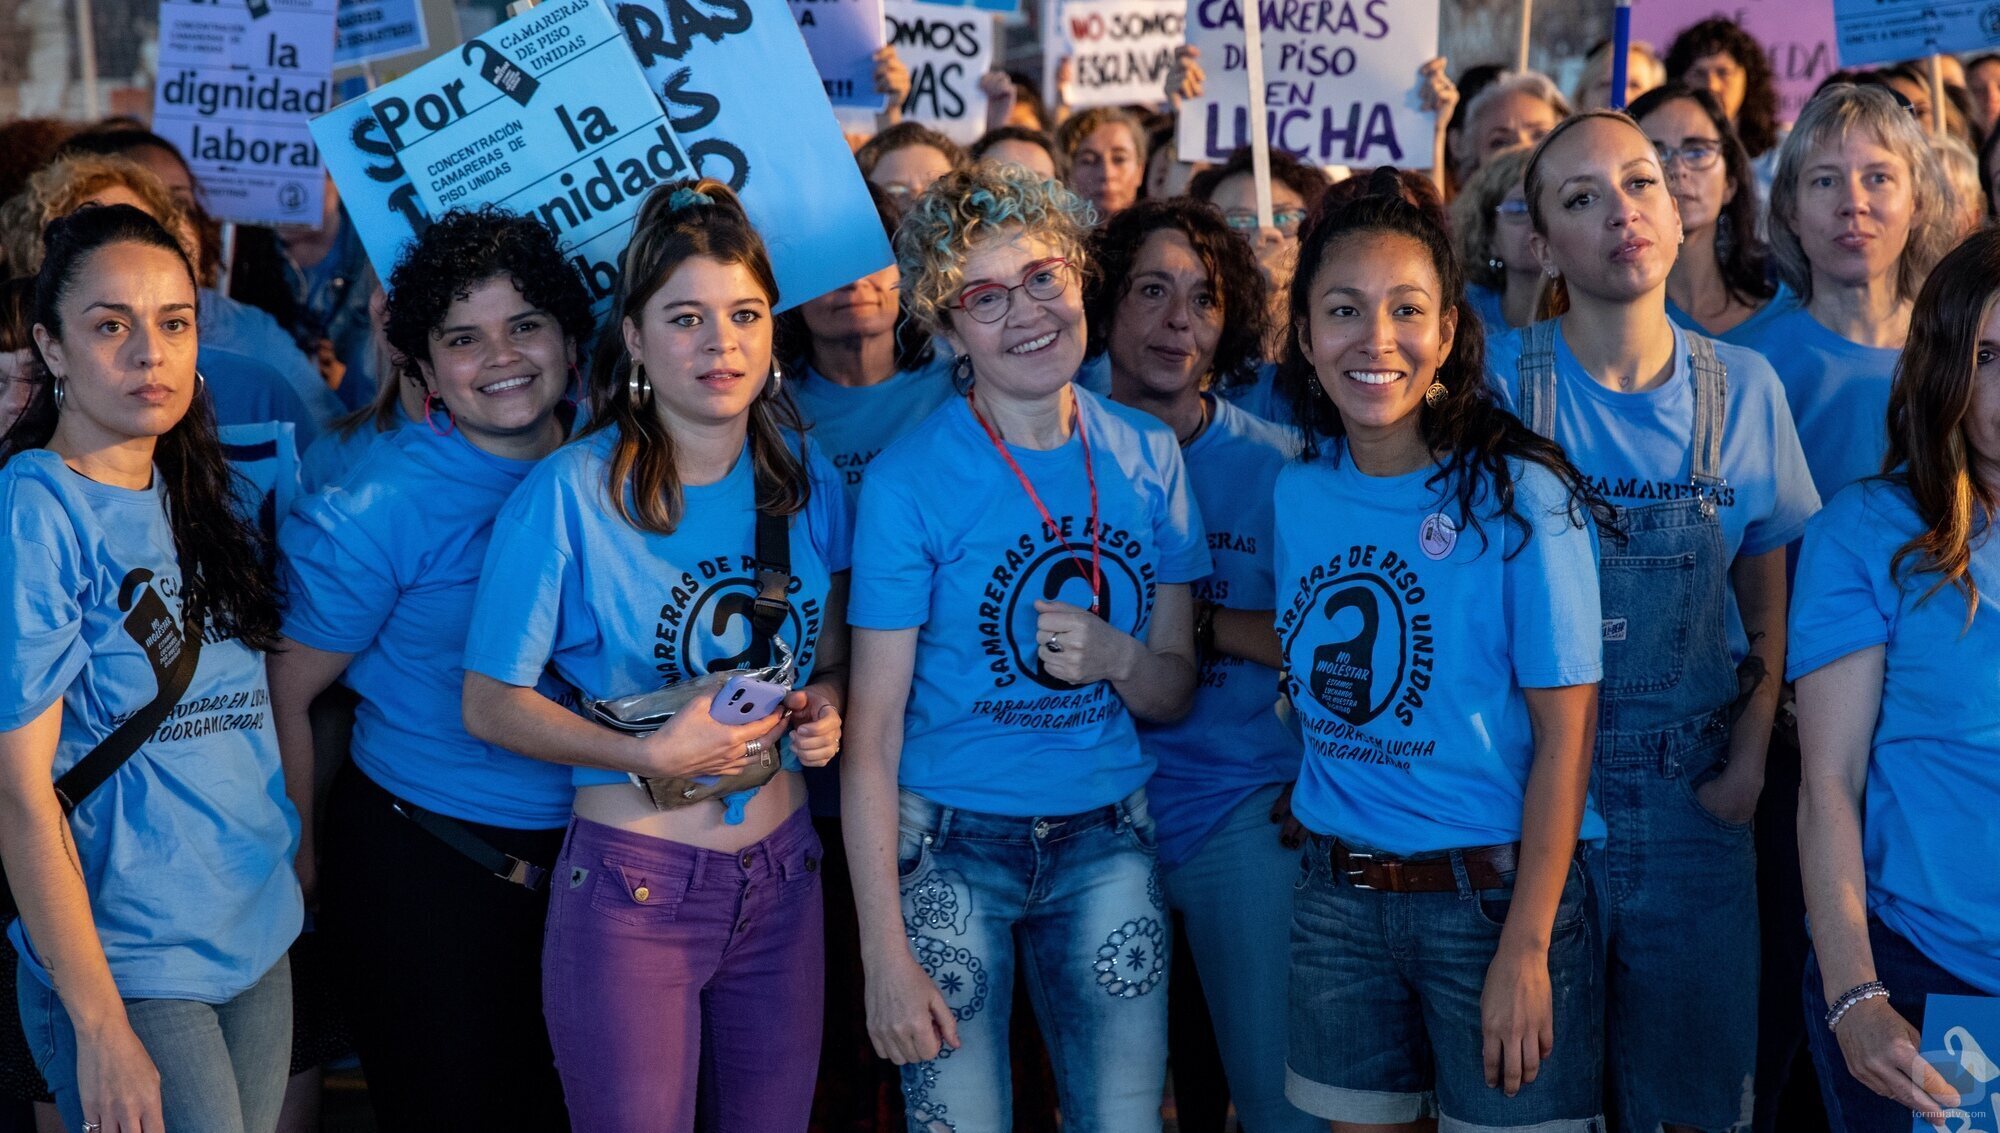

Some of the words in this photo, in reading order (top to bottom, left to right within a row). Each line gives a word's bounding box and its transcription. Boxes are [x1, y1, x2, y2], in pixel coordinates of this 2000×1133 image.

[500, 0, 589, 49] CAMARERAS
[515, 42, 537, 60] DE
[538, 25, 571, 50] PISO
[268, 33, 299, 68] la
[530, 34, 587, 70] UNIDAS
[164, 71, 327, 115] dignidad
[371, 78, 469, 151] Por
[1265, 81, 1315, 105] EN
[192, 125, 320, 168] laboral
[427, 119, 524, 178] CONCENTRACIÓN
[554, 104, 619, 154] la
[1206, 102, 1404, 160] LUCHA
[431, 148, 504, 193] CAMARERAS
[508, 136, 527, 153] DE
[438, 185, 468, 207] PISO
[469, 161, 513, 192] UNIDAS
[697, 556, 733, 579] DE
[741, 555, 803, 595] PO
[1347, 545, 1377, 568] DE
[1379, 551, 1426, 606] PISO
[979, 533, 1035, 688] CAMARERAS
[1042, 516, 1073, 542] DE
[1083, 516, 1142, 559] PISO
[1316, 660, 1370, 681] MOLESTAR
[1336, 651, 1350, 664] NO
[1395, 613, 1435, 727] UNIDAS
[227, 691, 249, 709] EN
[1387, 739, 1436, 757] LUCHA
